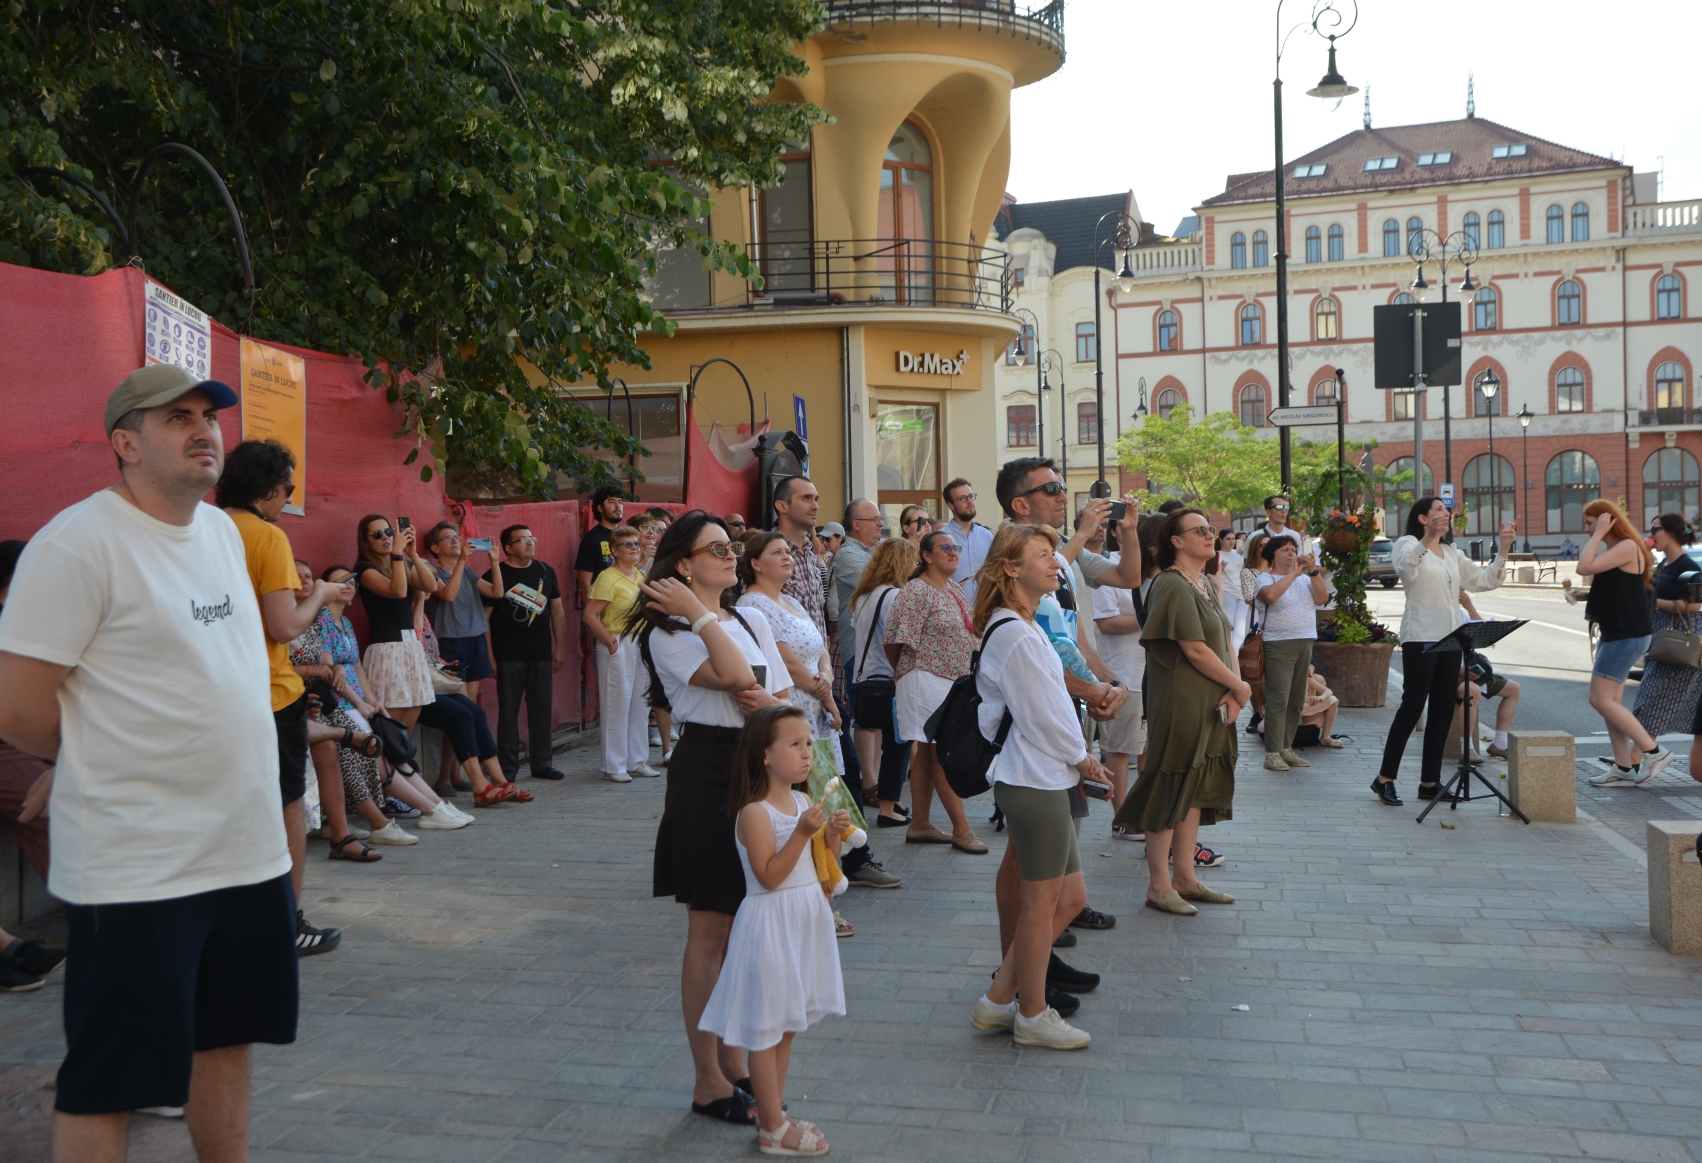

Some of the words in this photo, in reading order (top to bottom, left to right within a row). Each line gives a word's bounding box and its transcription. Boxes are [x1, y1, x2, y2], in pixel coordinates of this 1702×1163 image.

[184, 304, 202, 322] LUCRU
[280, 377, 297, 390] LUCRU
[190, 594, 234, 626] legend
